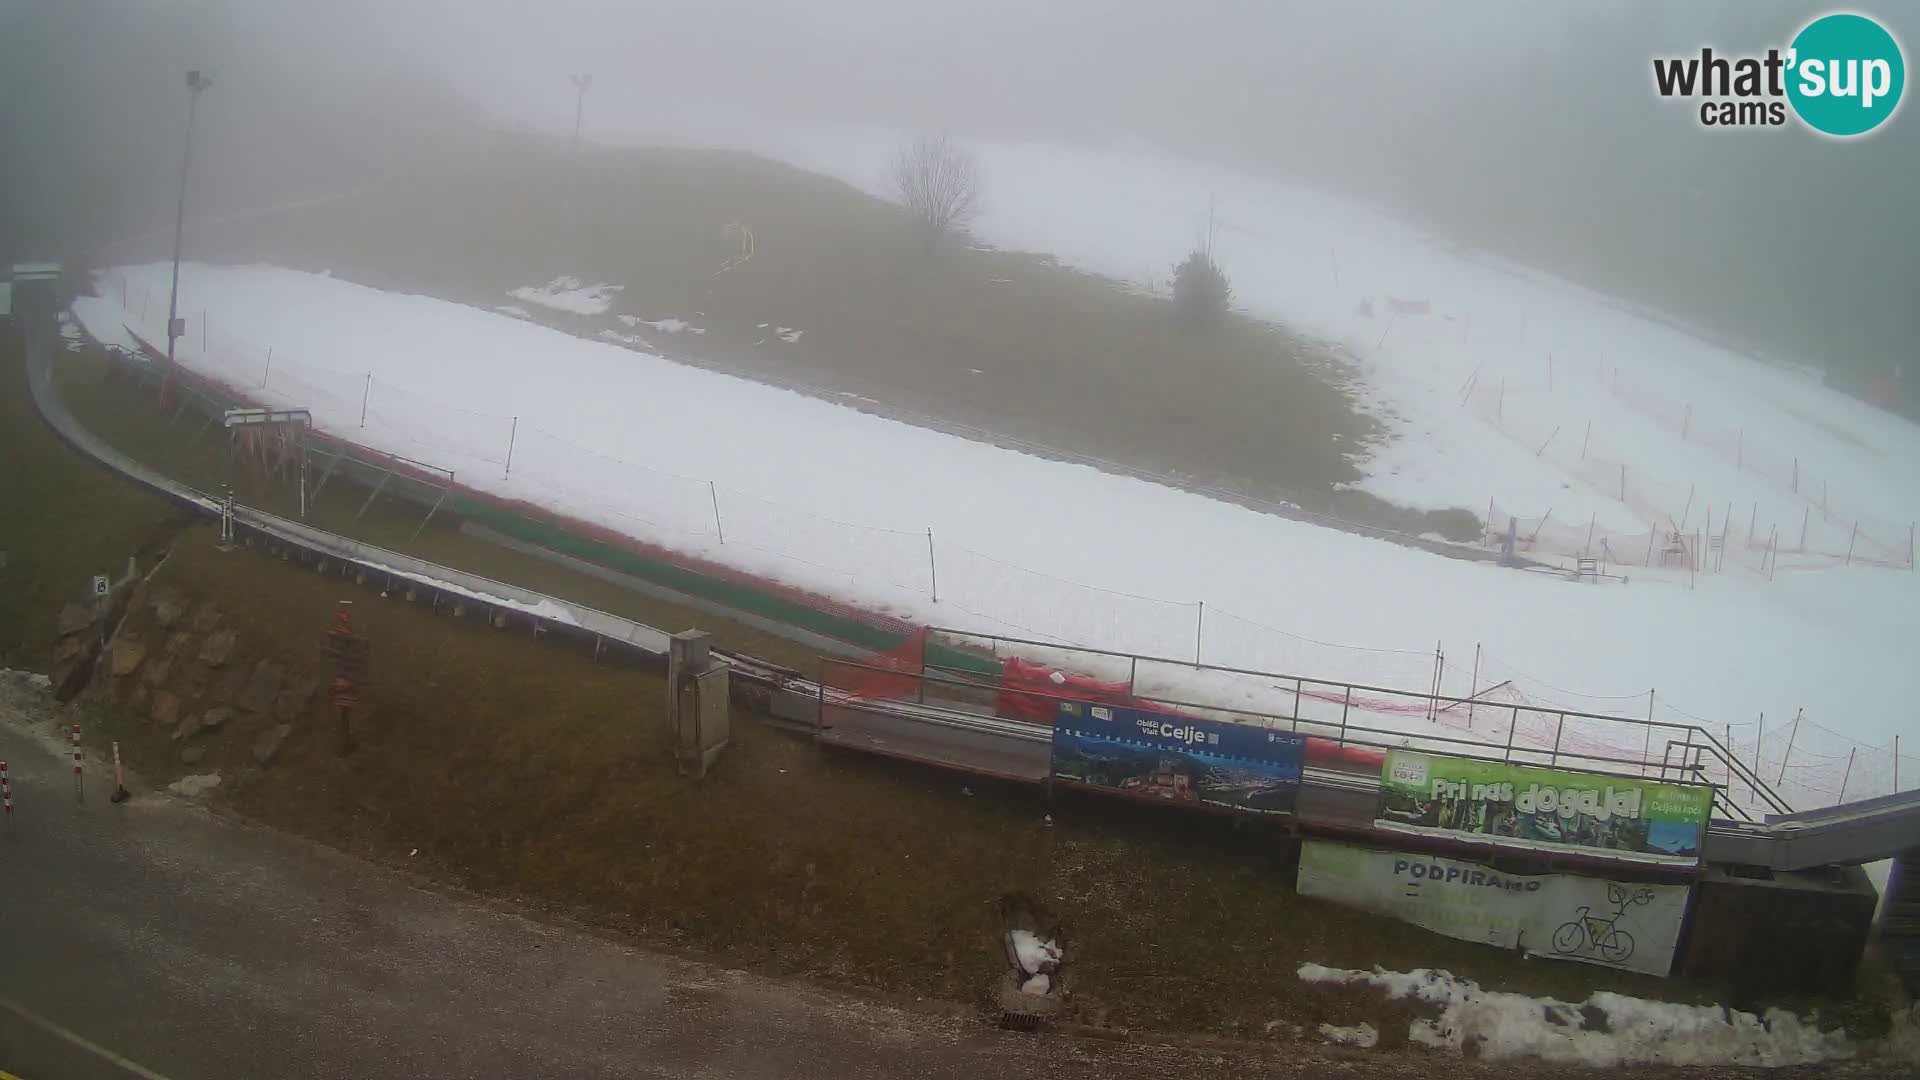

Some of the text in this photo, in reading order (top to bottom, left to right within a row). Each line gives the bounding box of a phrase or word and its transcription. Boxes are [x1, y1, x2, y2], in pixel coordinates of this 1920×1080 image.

[1160, 723, 1205, 744] Celje
[1431, 777, 1467, 801] Pri
[1471, 782, 1514, 801] nas
[1393, 859, 1541, 892] PODPIRAMO
